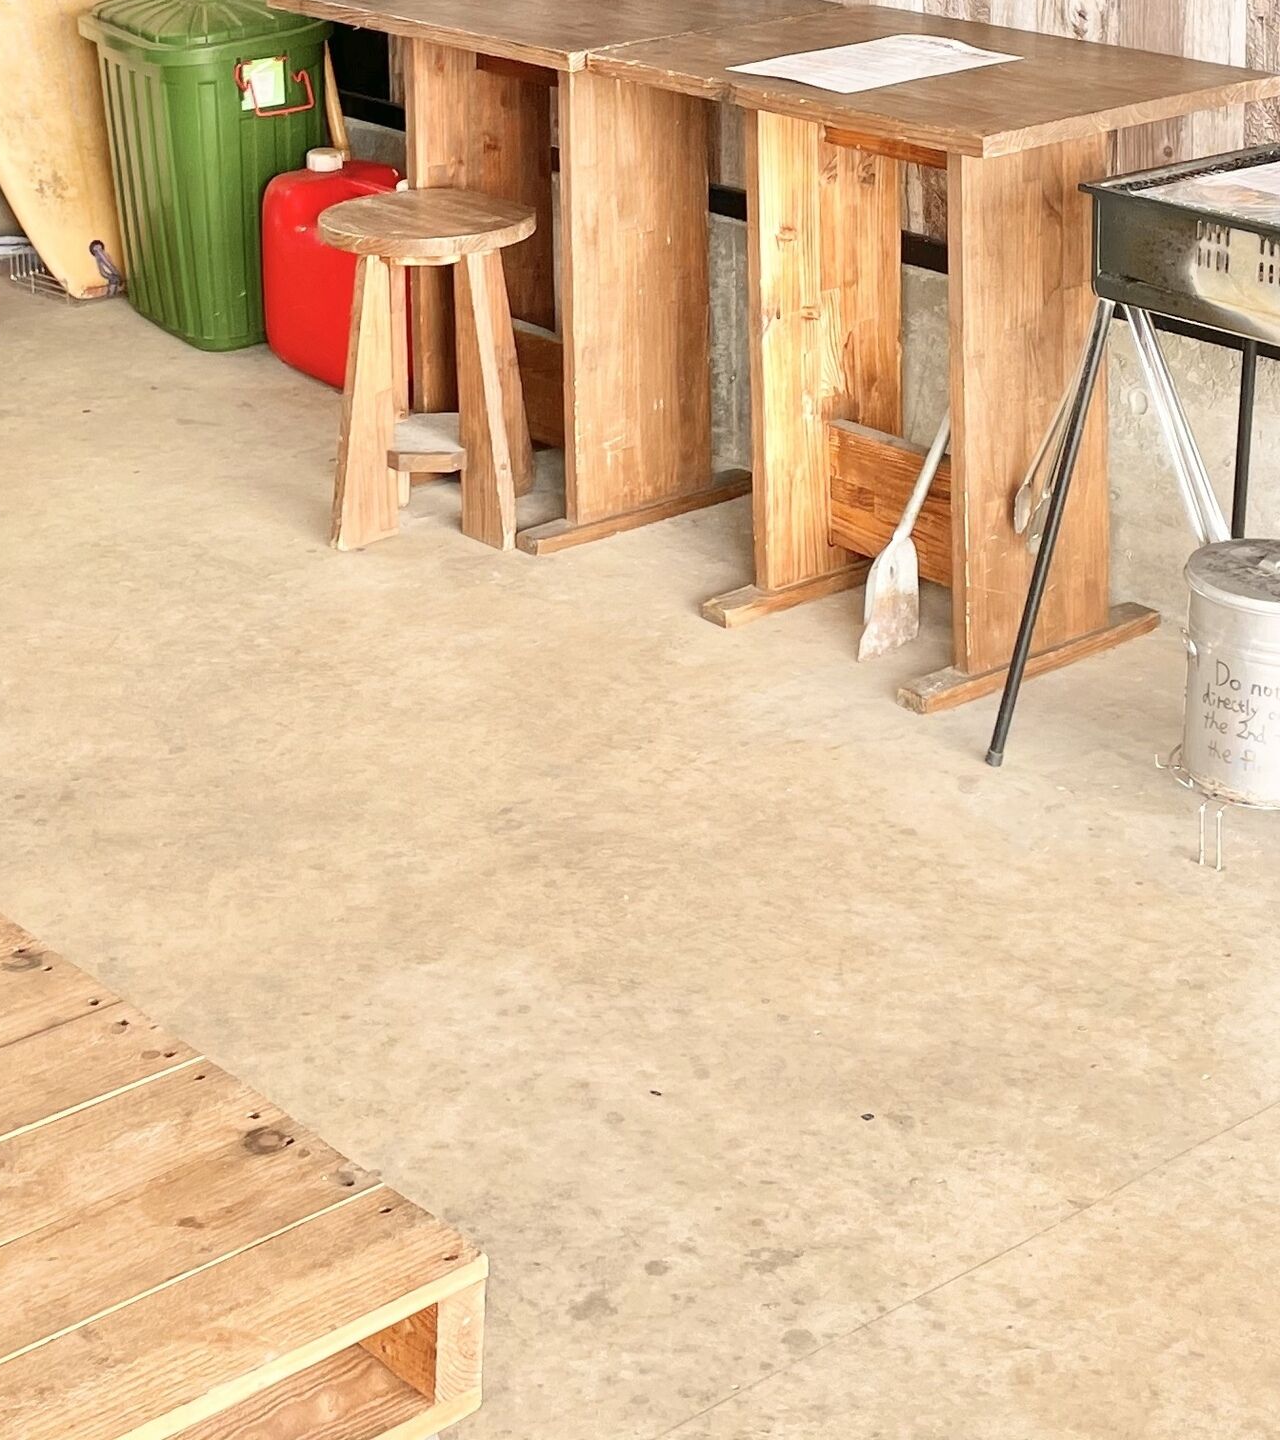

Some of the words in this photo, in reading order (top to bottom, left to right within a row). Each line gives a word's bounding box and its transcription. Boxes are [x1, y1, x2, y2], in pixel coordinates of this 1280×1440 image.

[1216, 659, 1241, 691] Do
[1203, 683, 1257, 722] directly
[1204, 711, 1228, 734] the
[1208, 740, 1232, 763] the
